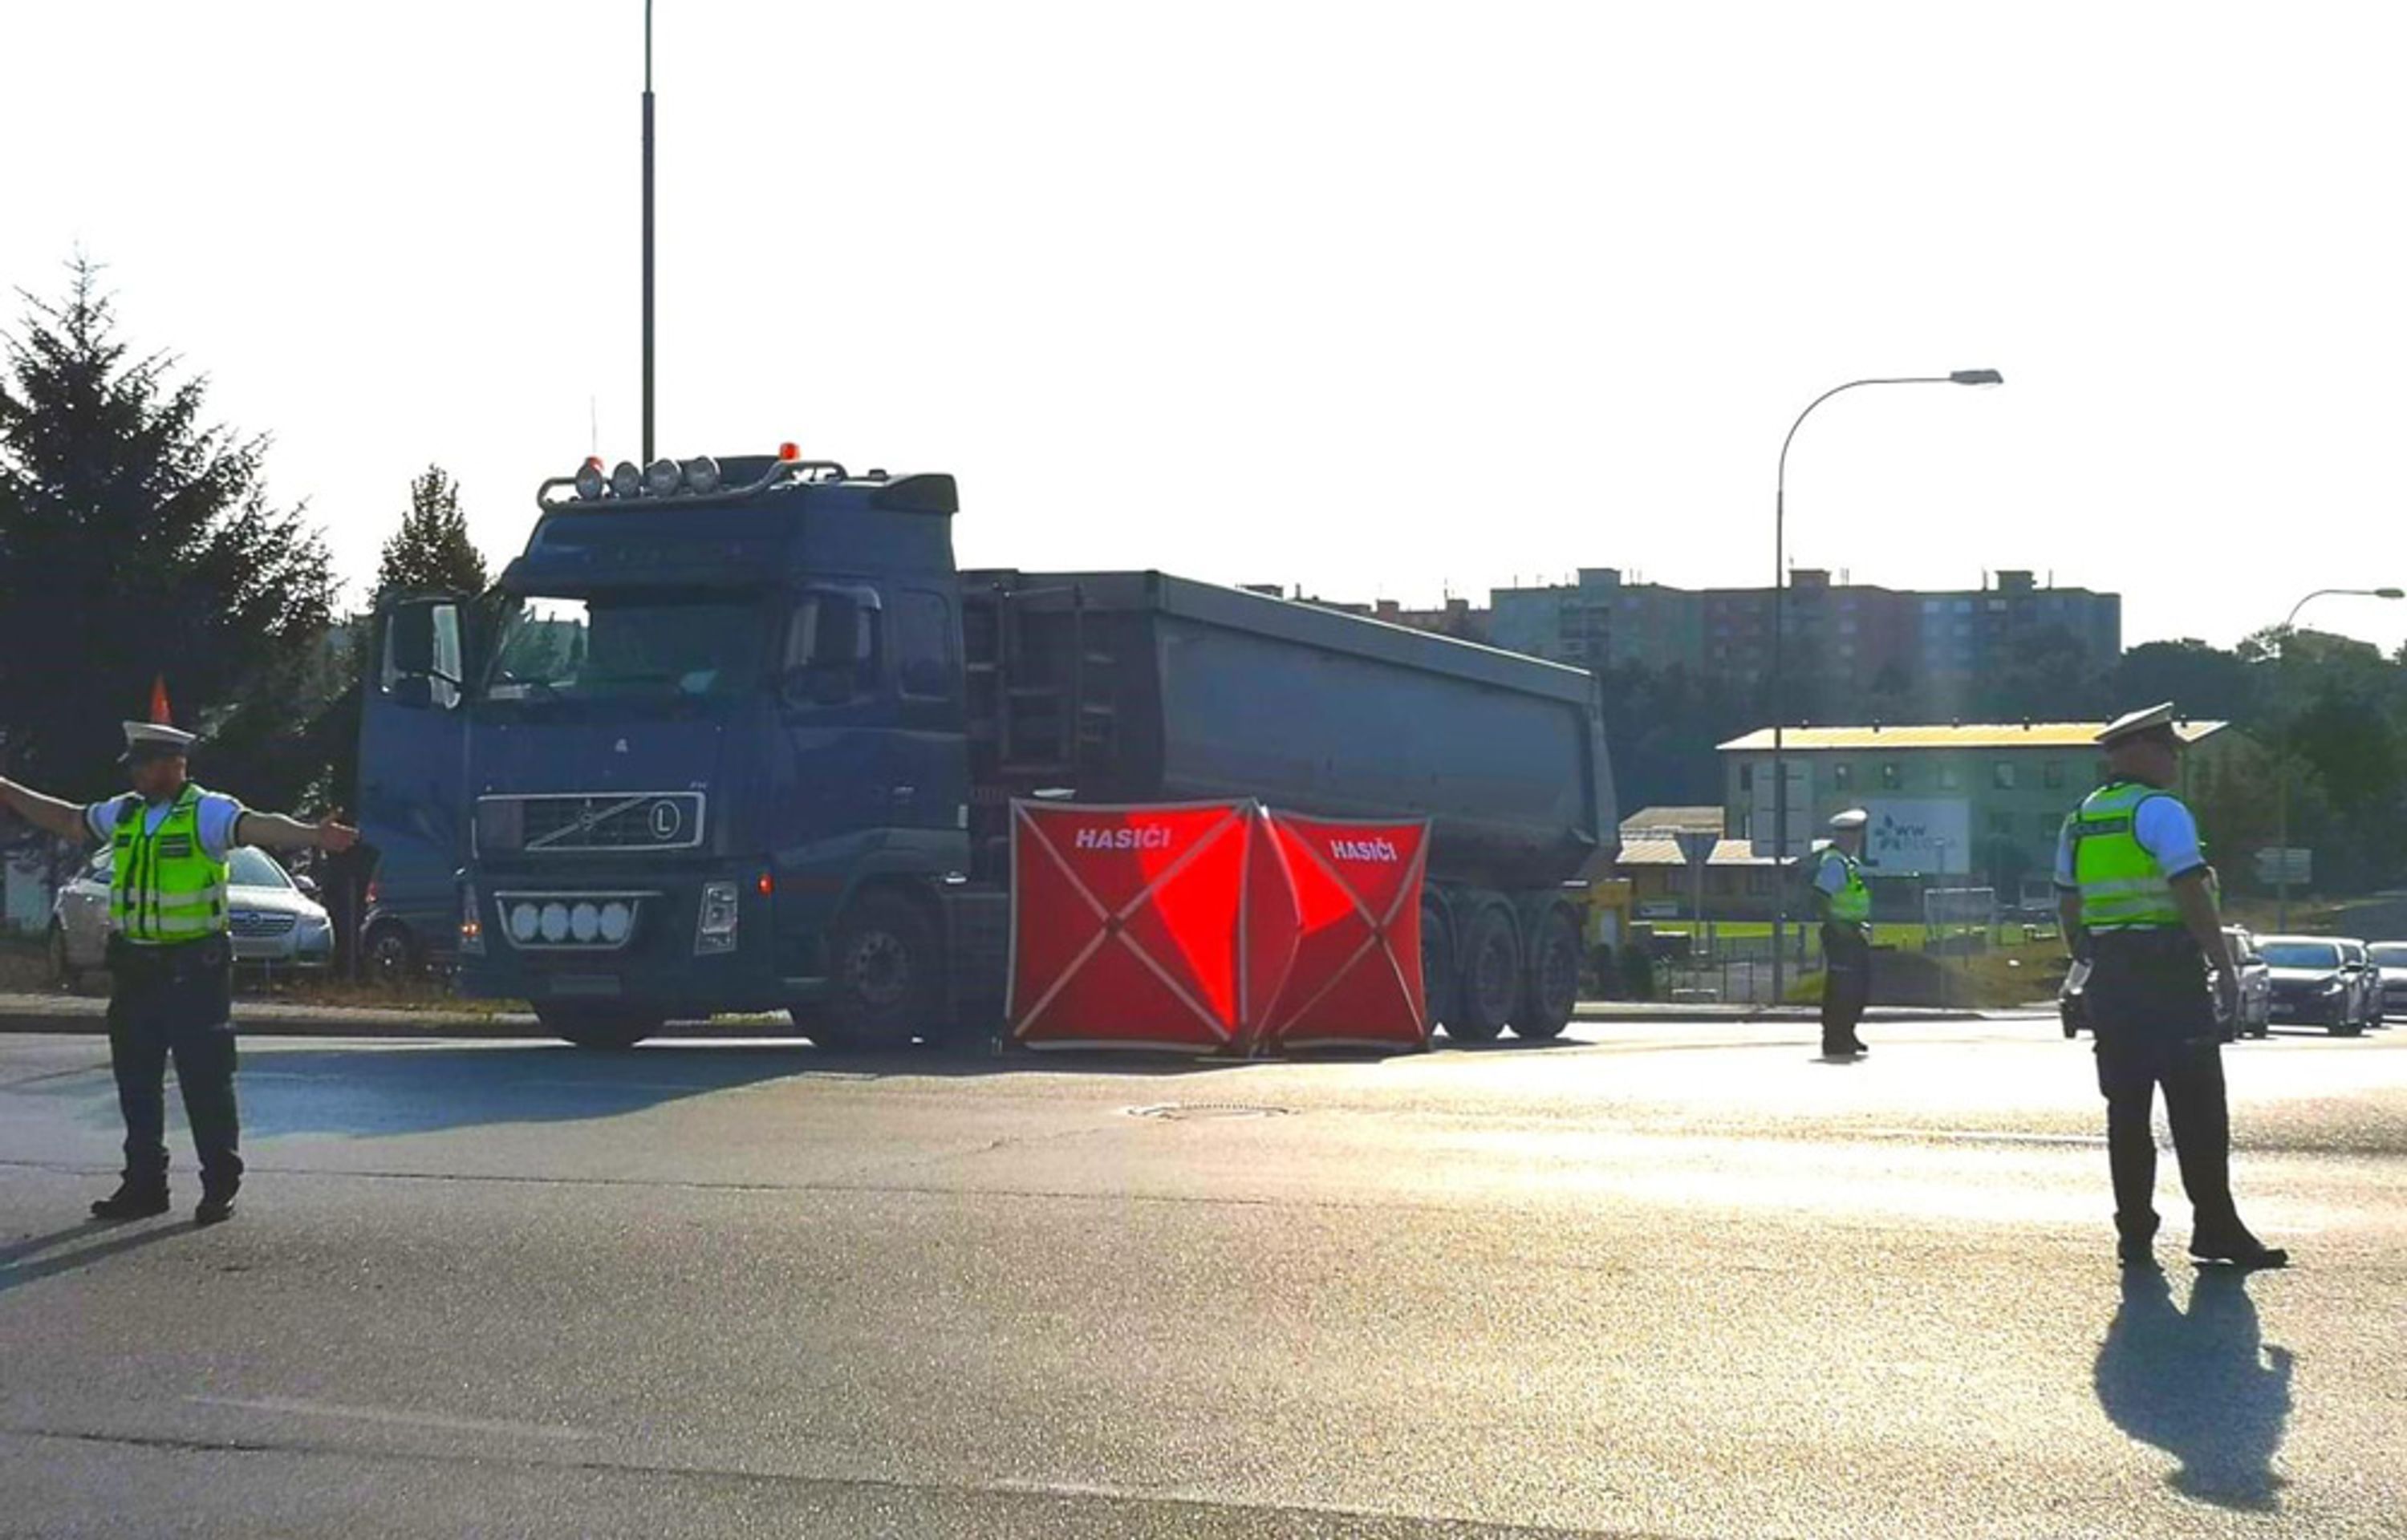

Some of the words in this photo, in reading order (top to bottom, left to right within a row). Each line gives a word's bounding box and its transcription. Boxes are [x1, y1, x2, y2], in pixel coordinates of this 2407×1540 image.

[658, 808, 671, 831] L
[1076, 823, 1171, 849] HASIČI
[1330, 837, 1398, 861] HASIČI
